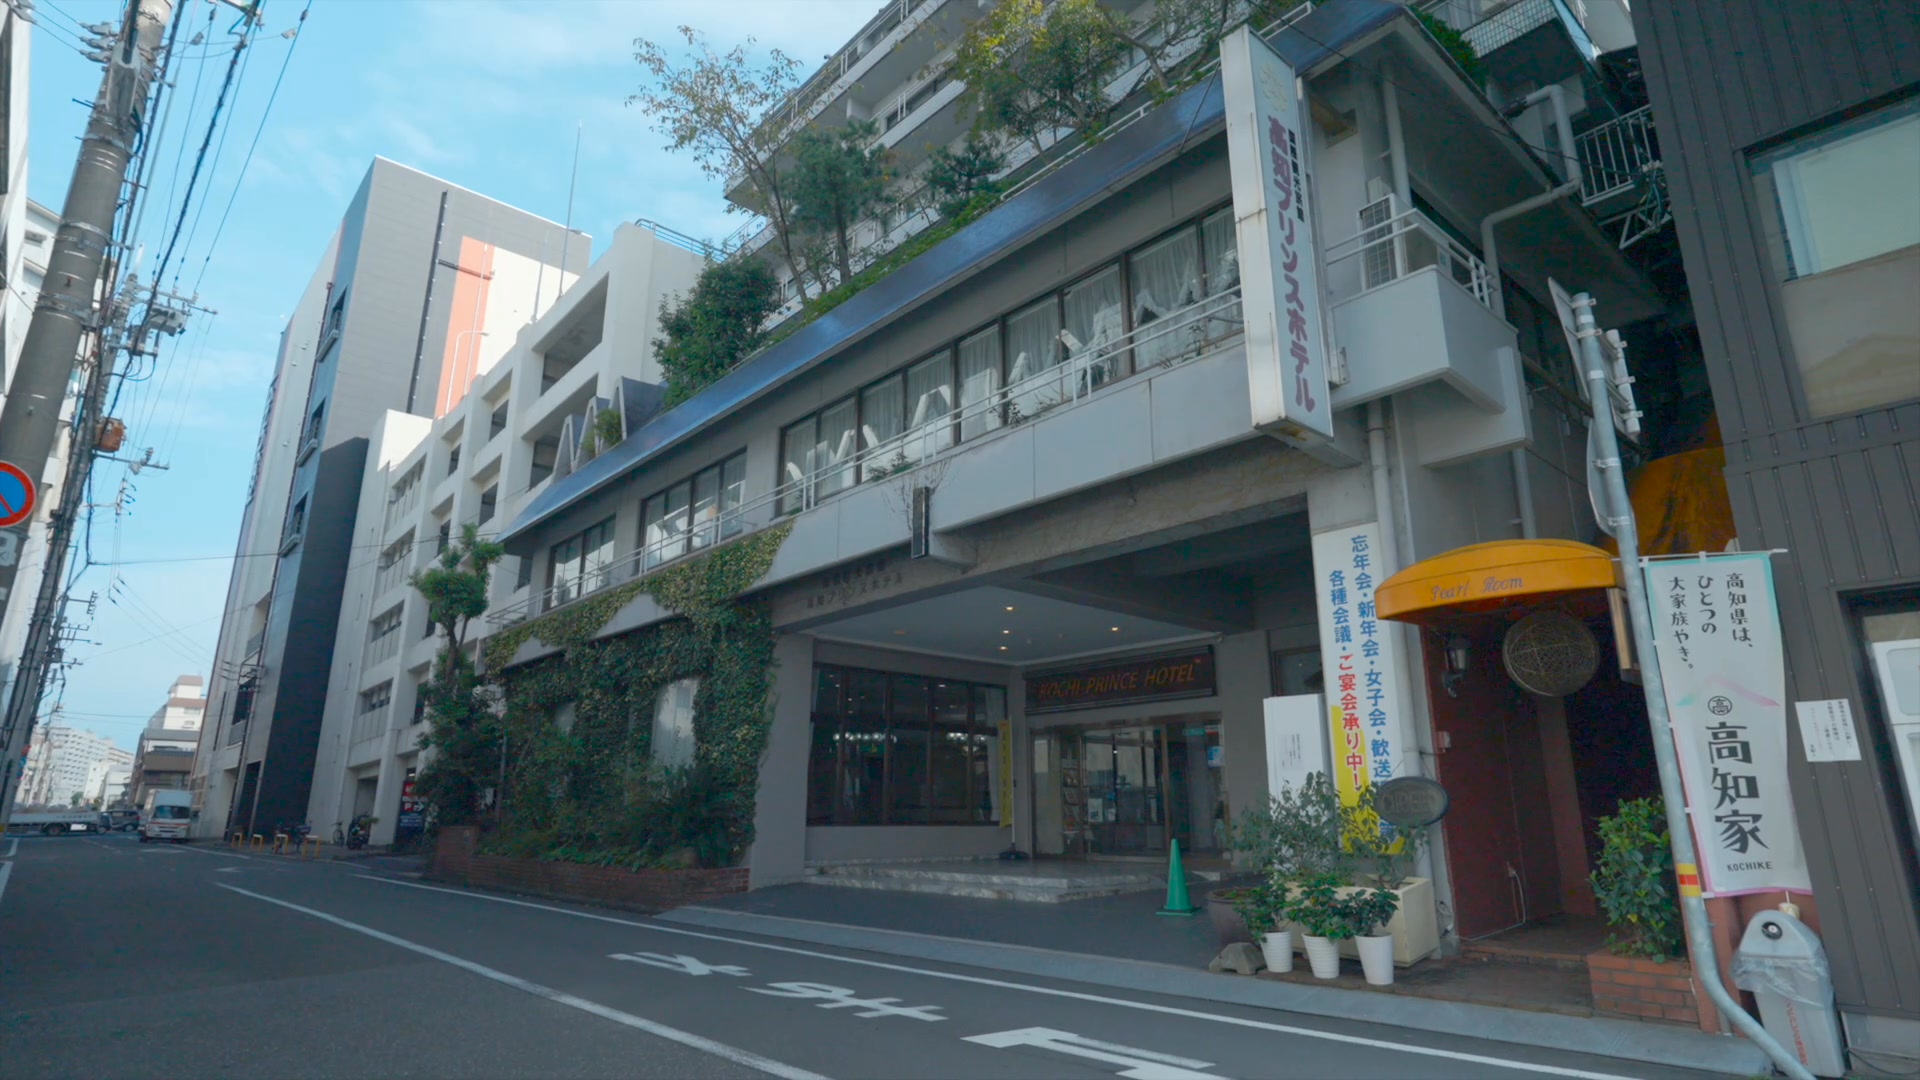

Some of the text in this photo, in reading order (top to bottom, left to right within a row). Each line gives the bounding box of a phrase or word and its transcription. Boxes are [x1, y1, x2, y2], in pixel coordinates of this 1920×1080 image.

[1267, 115, 1316, 413] 高知プリンスホテル
[1432, 576, 1524, 602] Pearl Room
[1668, 576, 1694, 669] 大家族やき。
[1697, 575, 1717, 635] ひとつの
[1726, 572, 1753, 648] 高知県は、
[1039, 662, 1196, 699] KOCHI PRINCE HOTEL
[1351, 535, 1398, 842] 忘年会・新年会・女子会・歓送
[1705, 721, 1770, 854] 高知家
[1726, 861, 1773, 872] KOCHIKE
